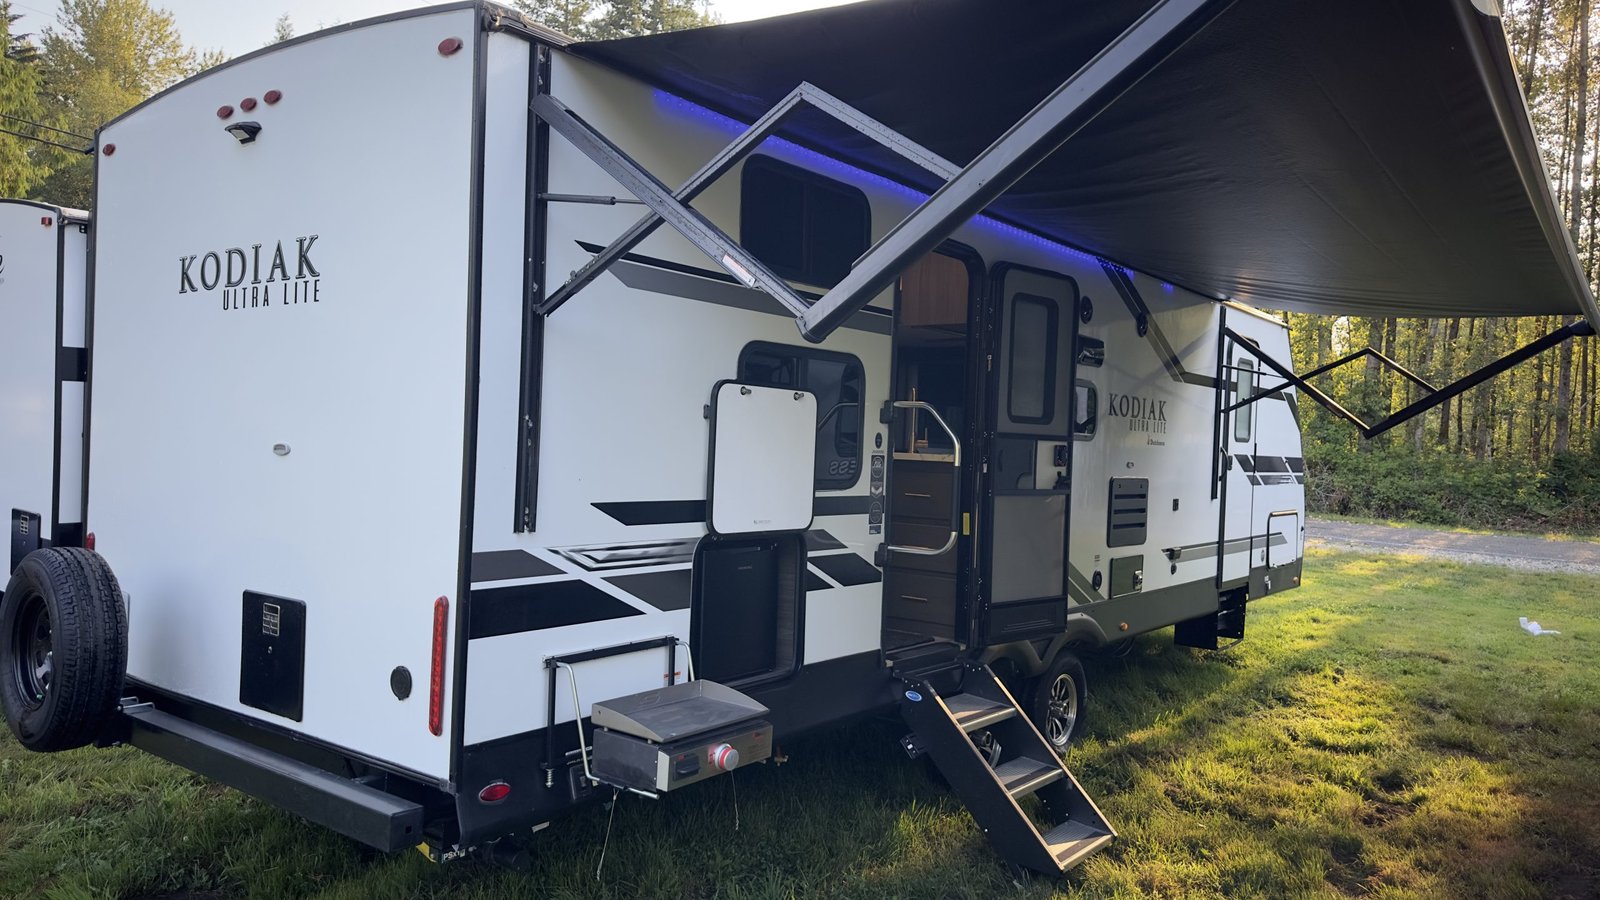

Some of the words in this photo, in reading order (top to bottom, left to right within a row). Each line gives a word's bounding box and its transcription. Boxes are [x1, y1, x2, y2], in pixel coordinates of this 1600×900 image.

[179, 234, 320, 294] KODIAK
[223, 285, 269, 310] ULTRA
[283, 279, 320, 305] LITE
[1108, 393, 1167, 421] KODIAK
